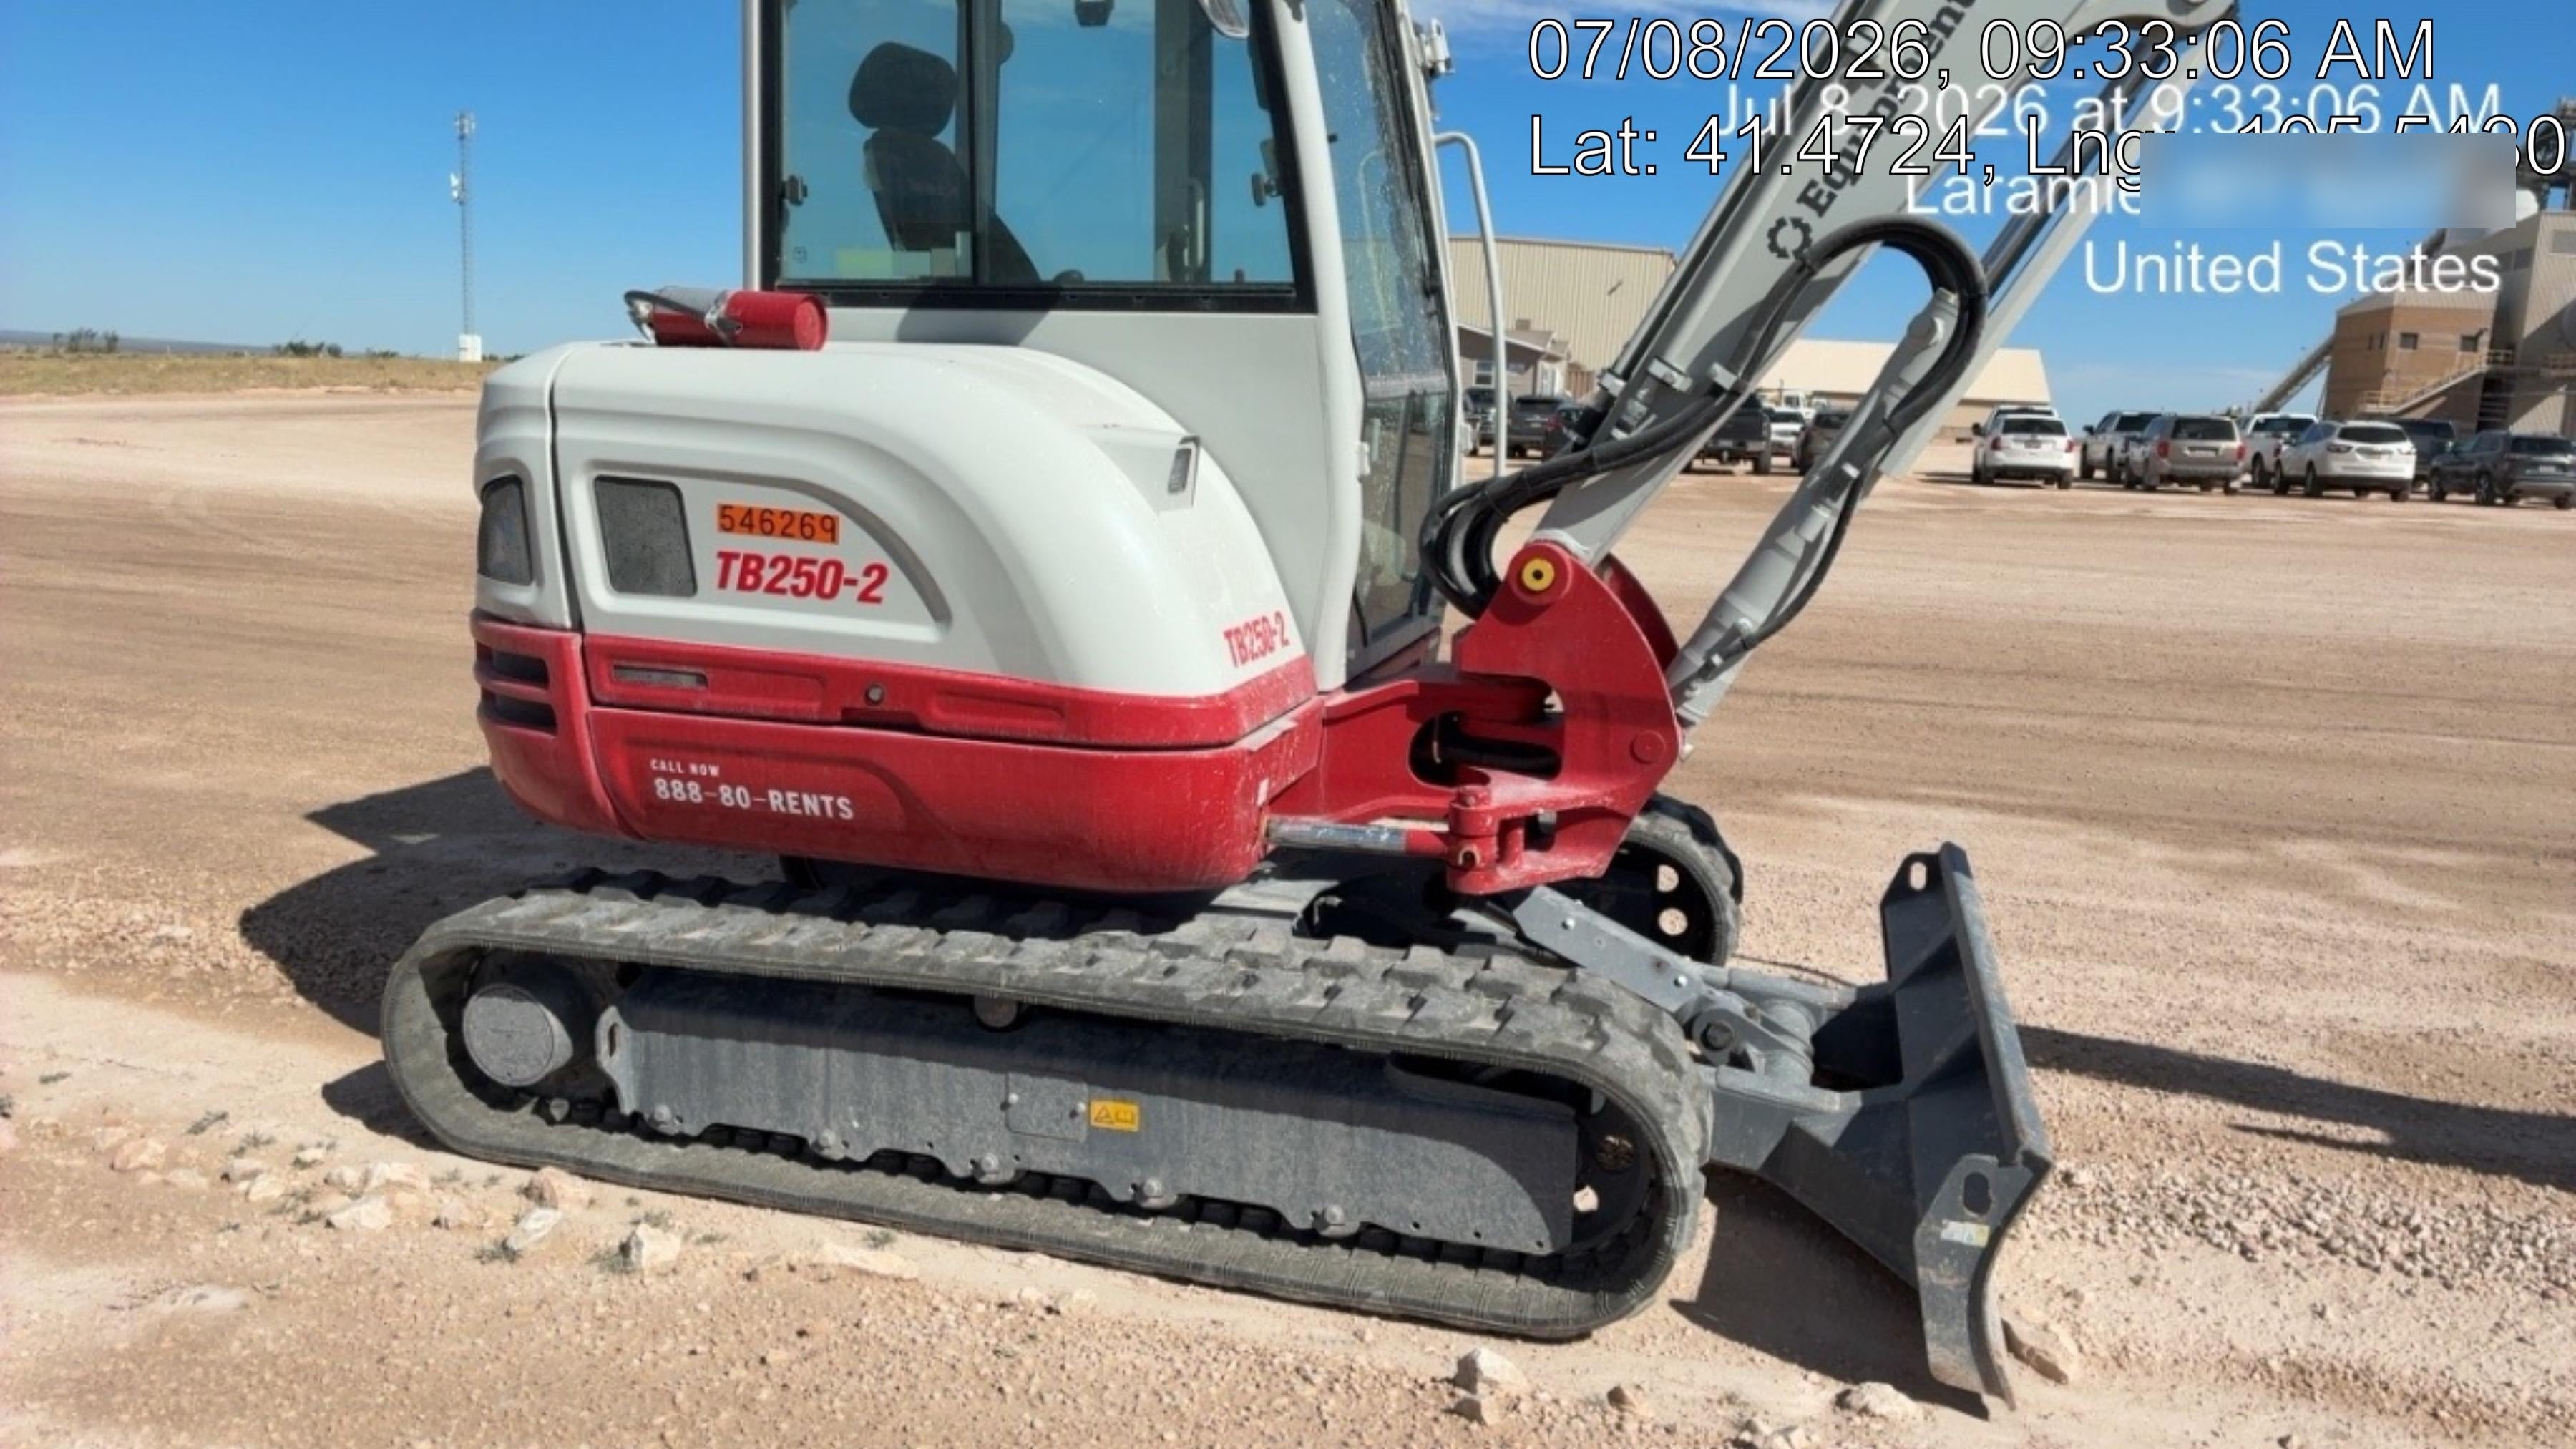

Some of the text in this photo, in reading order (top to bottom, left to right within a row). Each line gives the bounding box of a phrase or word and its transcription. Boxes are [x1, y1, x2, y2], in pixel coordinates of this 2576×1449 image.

[718, 504, 836, 543] 546269
[716, 550, 889, 605] TB250-2
[1223, 610, 1291, 668] TB250-2
[650, 758, 720, 777] CALL NOW
[654, 777, 854, 821] 888-80-RENTS
